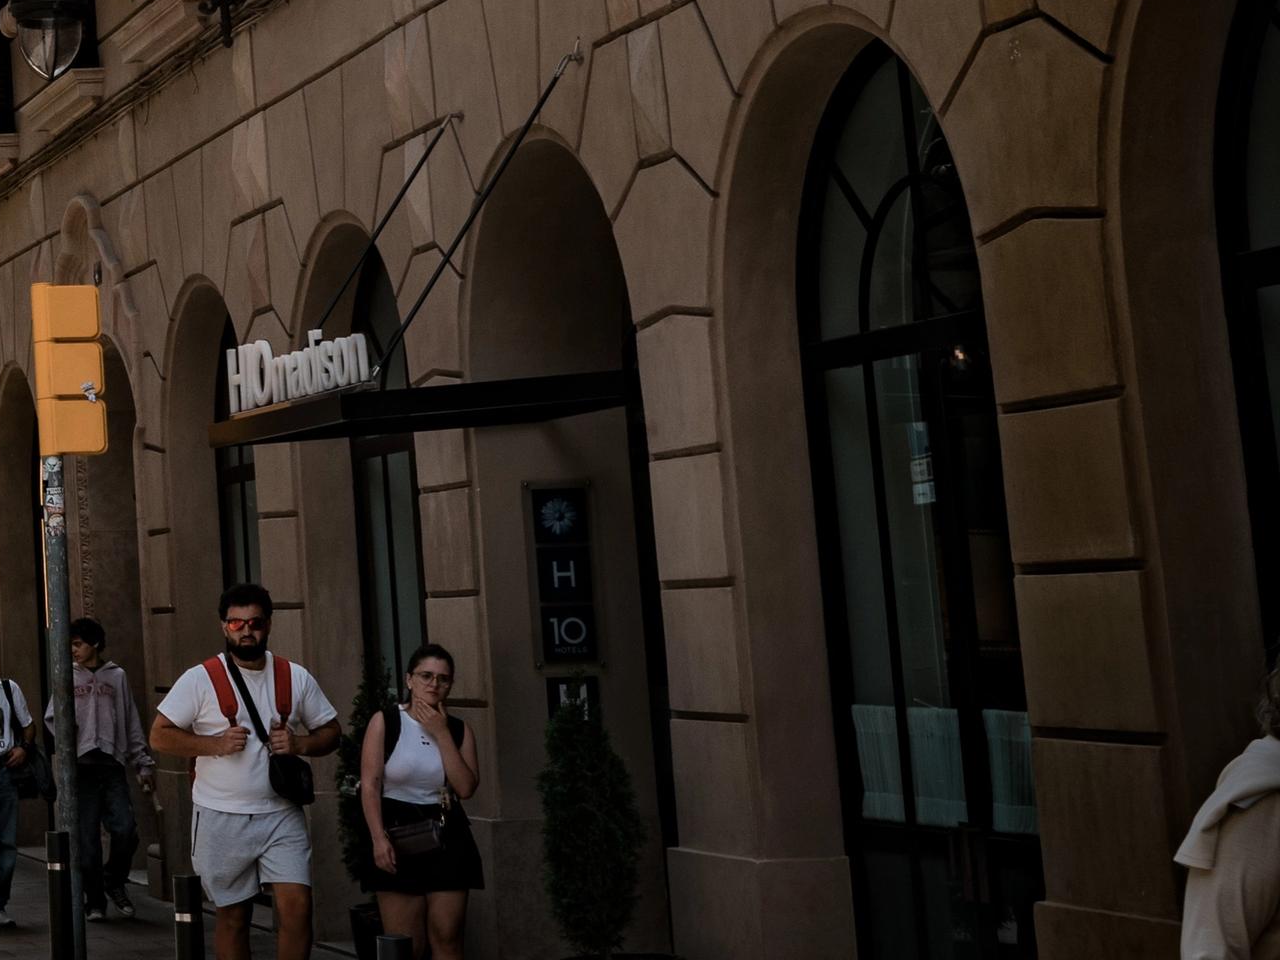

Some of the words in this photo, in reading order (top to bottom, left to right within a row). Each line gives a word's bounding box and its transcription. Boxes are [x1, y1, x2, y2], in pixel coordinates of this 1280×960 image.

[552, 560, 576, 588] H
[549, 617, 587, 645] 10
[554, 646, 588, 654] HOTELS
